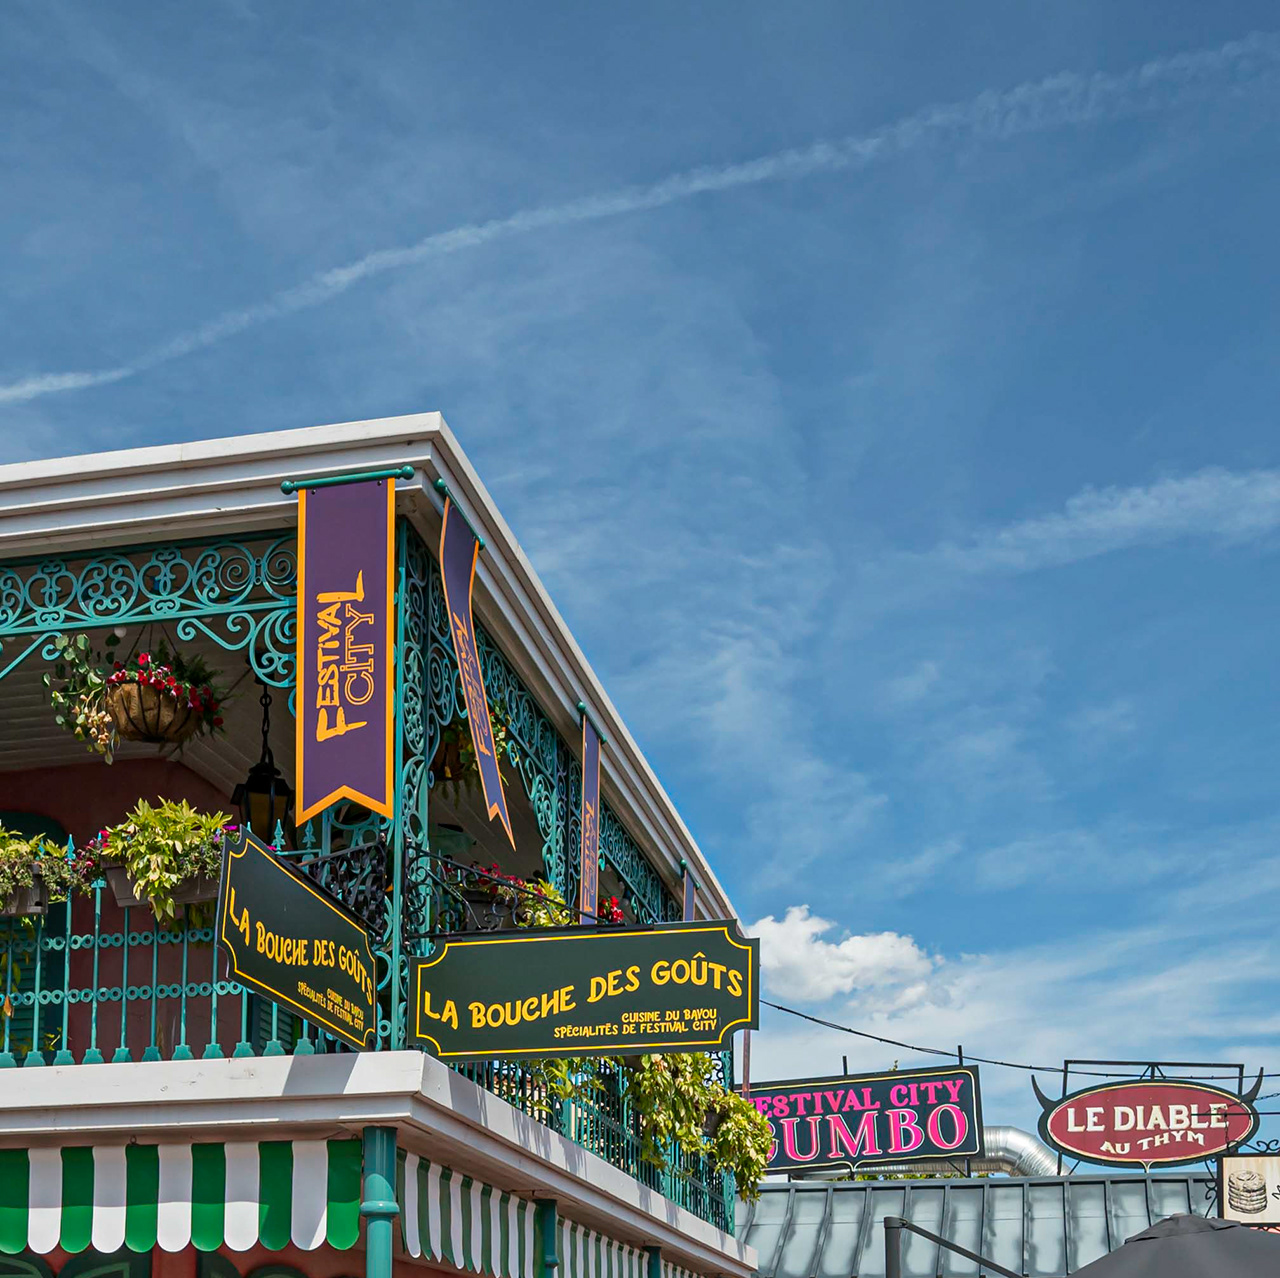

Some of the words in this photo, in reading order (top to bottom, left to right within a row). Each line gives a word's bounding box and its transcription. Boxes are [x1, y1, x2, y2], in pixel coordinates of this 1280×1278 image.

[316, 570, 368, 742] FESTIVAL
[340, 603, 375, 706] CITY
[229, 887, 250, 946] LA
[255, 921, 309, 966] BOUCHE
[312, 939, 336, 968] DES
[338, 945, 373, 1006] GOÛTS
[423, 991, 459, 1030] LA
[468, 985, 577, 1029] BOUCHE
[586, 965, 640, 1003] DES
[650, 951, 744, 998] GOÛTS
[554, 1023, 619, 1038] SPÉCIALITÉS
[621, 1023, 637, 1035] DE
[640, 1021, 689, 1034] FESTIVAL
[692, 1019, 717, 1032] CITY
[621, 1010, 660, 1023] CUISINE
[664, 1009, 680, 1021] DU
[683, 1008, 717, 1021] BAYOU
[751, 1087, 881, 1118] ESTIVAL
[890, 1079, 964, 1107] CITY
[1067, 1107, 1106, 1132] LE
[1113, 1103, 1230, 1131] DIABLE
[767, 1104, 969, 1162] UMBO
[1100, 1141, 1131, 1155] AU
[1136, 1130, 1205, 1151] THYM
